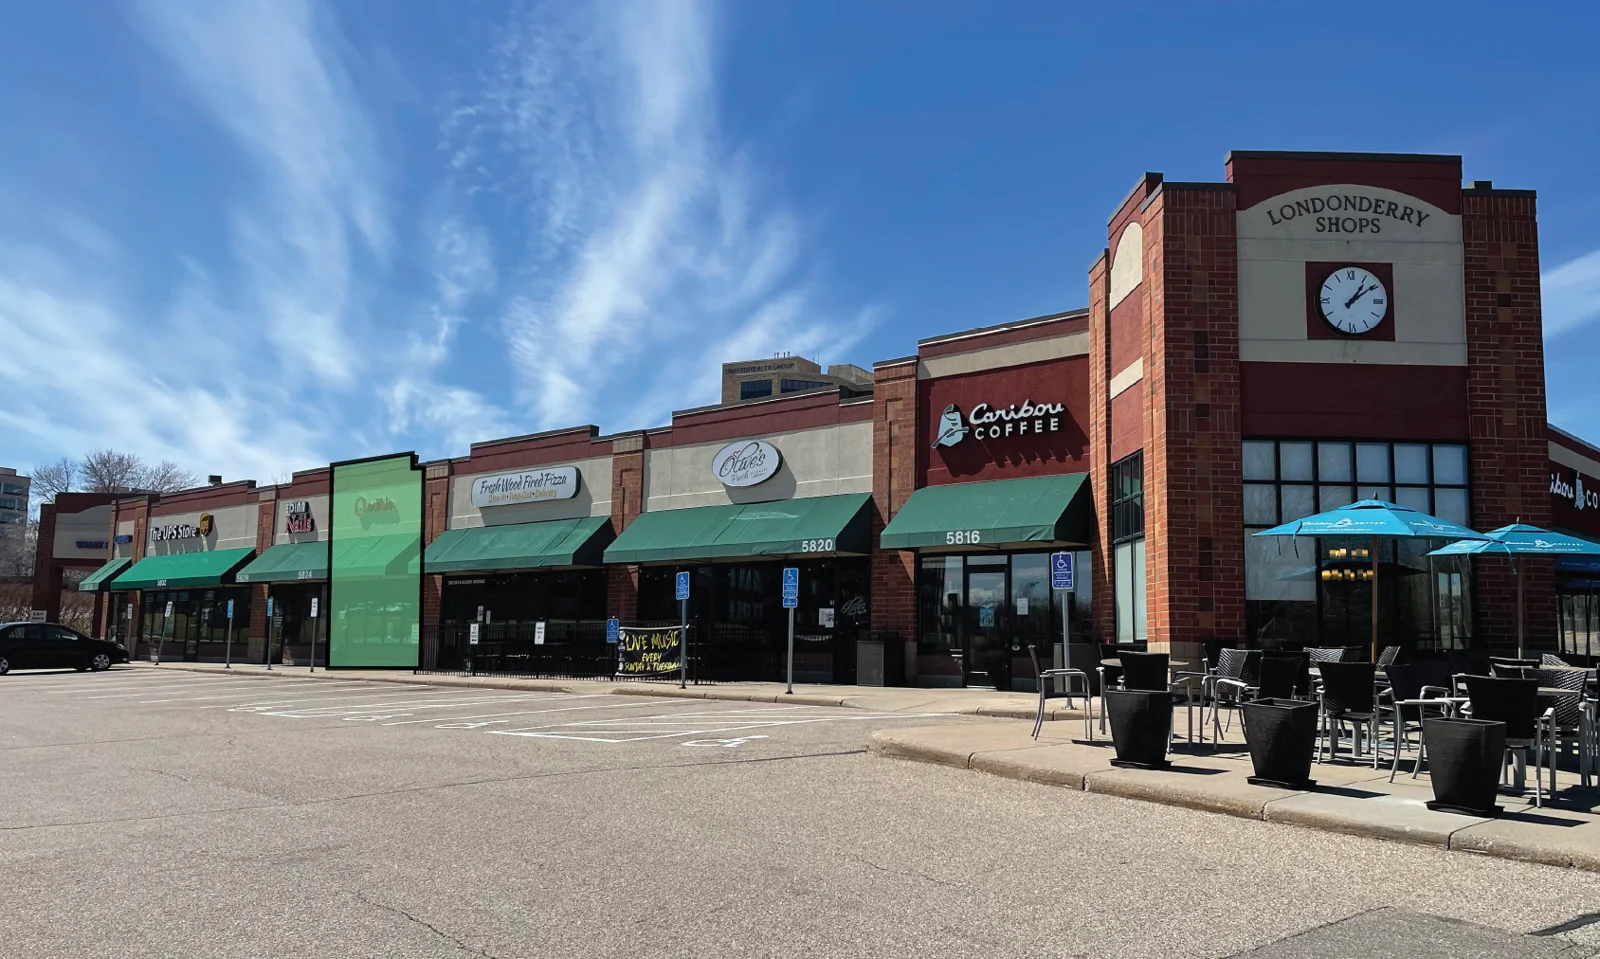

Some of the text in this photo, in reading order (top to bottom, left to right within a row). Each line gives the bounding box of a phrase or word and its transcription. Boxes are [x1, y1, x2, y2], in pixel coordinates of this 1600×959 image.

[1266, 195, 1430, 228] LONDONDERRY
[1316, 217, 1380, 233] SHOPS
[773, 363, 795, 371] GROUP
[969, 399, 1065, 425] Caribou
[974, 417, 1059, 440] COFFEE
[480, 472, 567, 494] Fresh Wood Fired Pizza
[1550, 472, 1574, 499] ibou
[150, 524, 197, 541] The UPS Store
[285, 514, 312, 533] Nails
[801, 539, 833, 553] 5820
[946, 530, 980, 545] 5816
[298, 570, 312, 579] 5824
[625, 634, 648, 652] LIVE
[651, 630, 680, 650] MUSIC
[641, 652, 663, 662] EVERY
